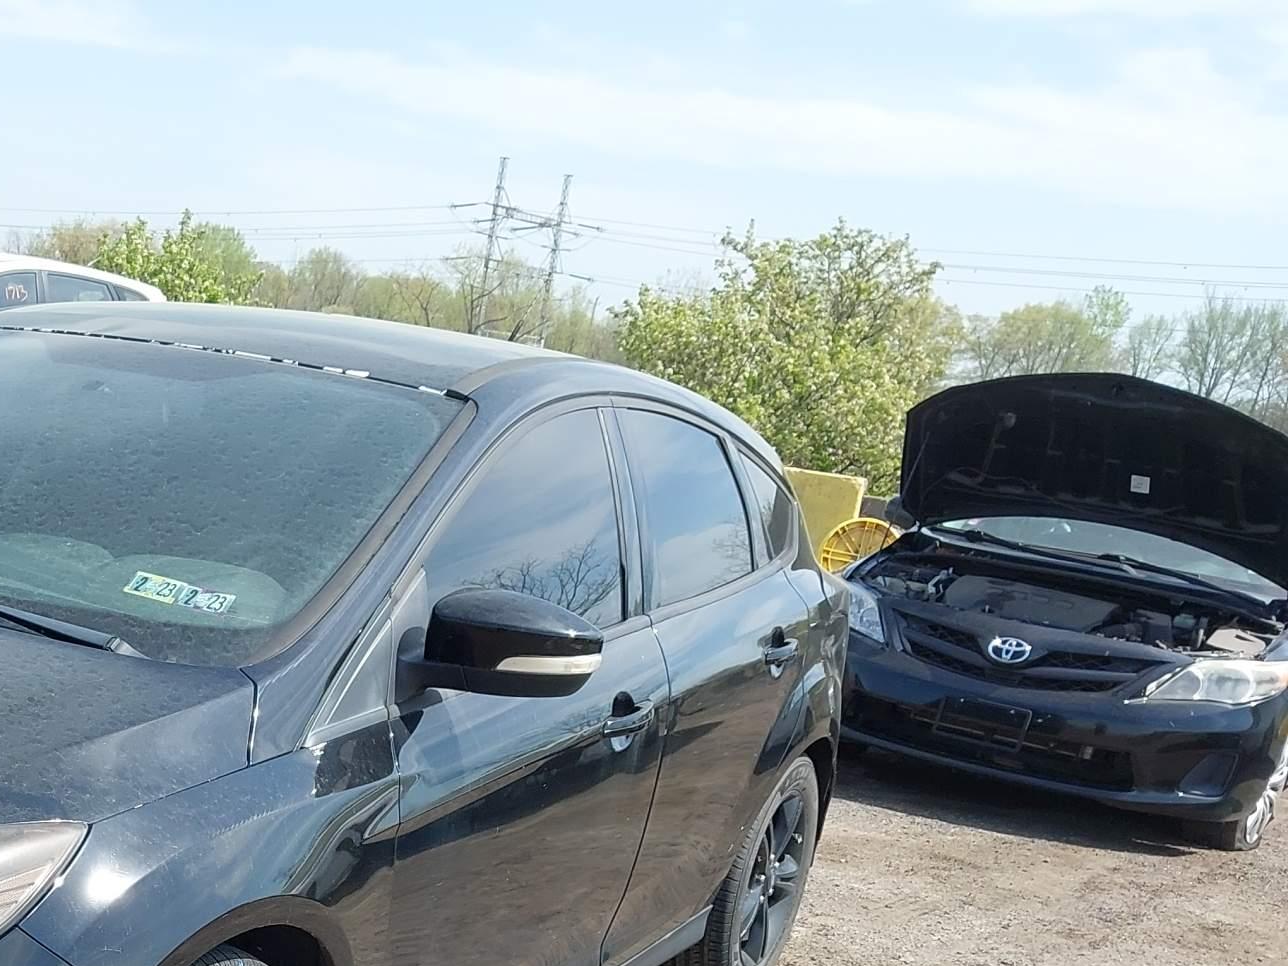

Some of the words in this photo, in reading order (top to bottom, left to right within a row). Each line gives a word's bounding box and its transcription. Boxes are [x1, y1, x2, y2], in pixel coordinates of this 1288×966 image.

[134, 576, 149, 592] 2
[156, 581, 177, 598] 23
[184, 589, 199, 606] 2
[206, 594, 227, 611] 23
